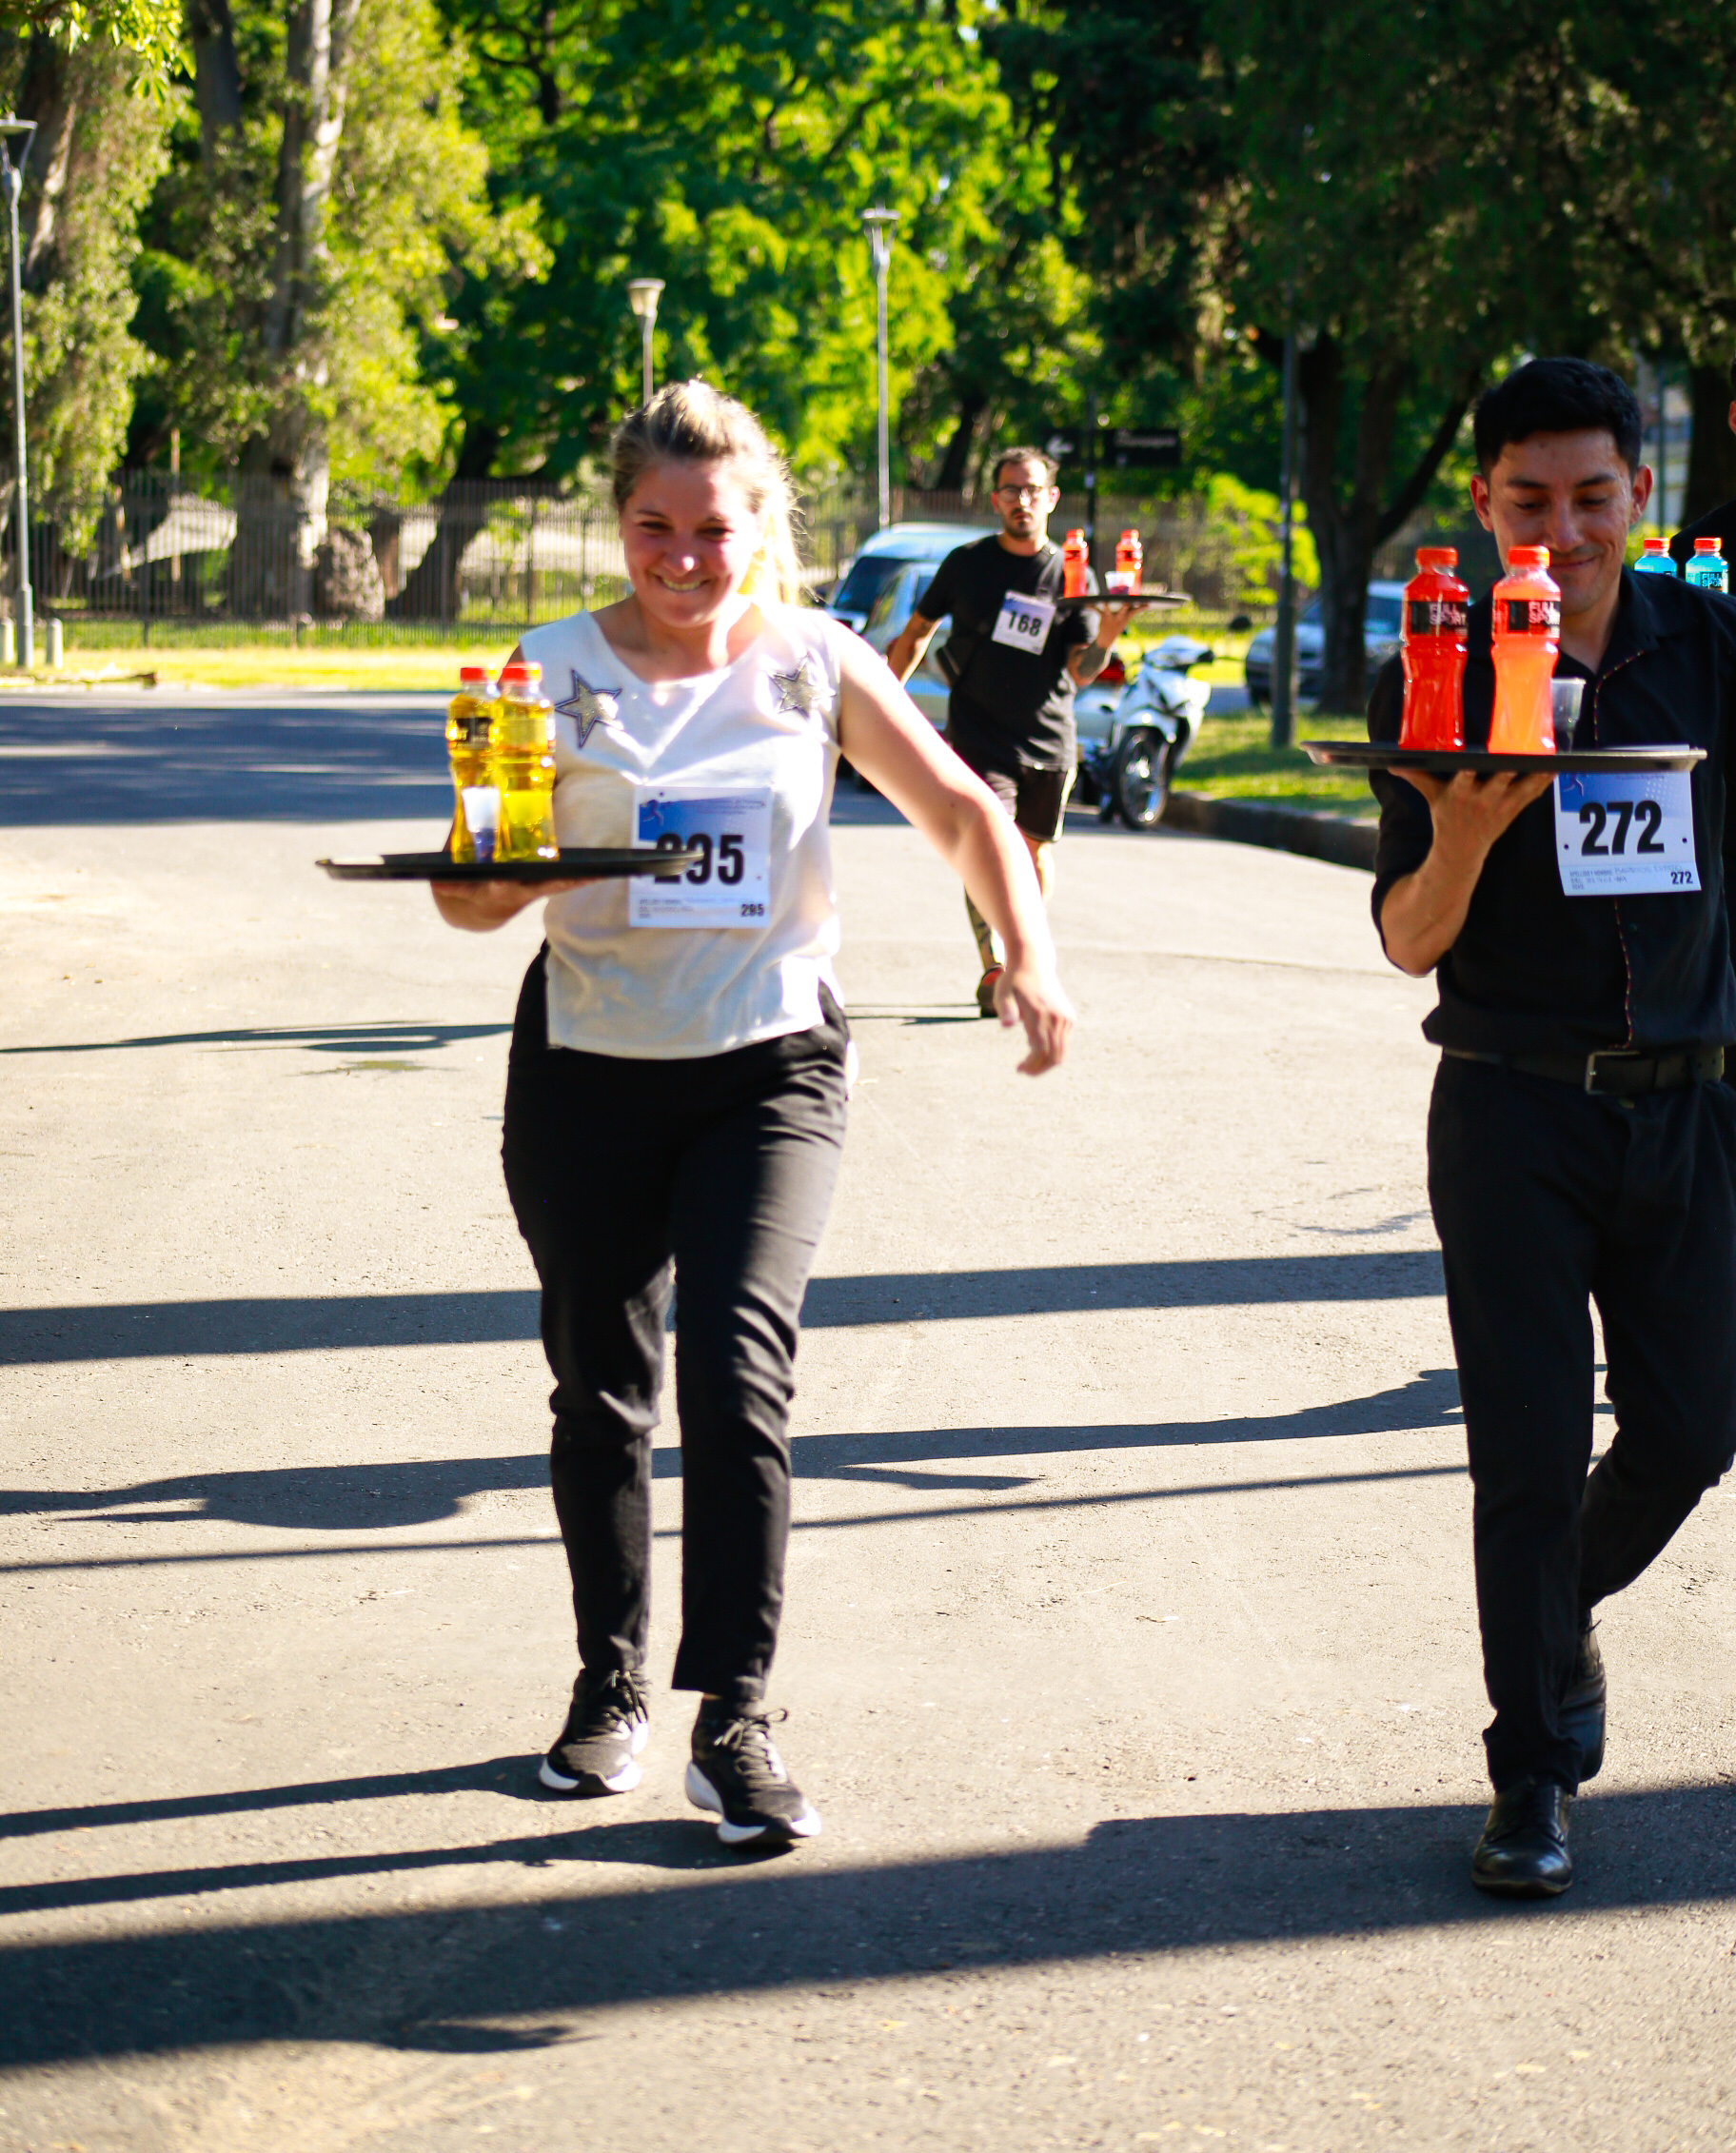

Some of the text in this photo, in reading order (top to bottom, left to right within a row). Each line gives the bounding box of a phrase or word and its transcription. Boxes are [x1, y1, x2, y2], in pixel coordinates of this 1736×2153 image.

[1008, 610, 1042, 637] 168
[1579, 800, 1665, 856] 272
[1670, 871, 1693, 884] 272
[740, 903, 765, 917] 295
